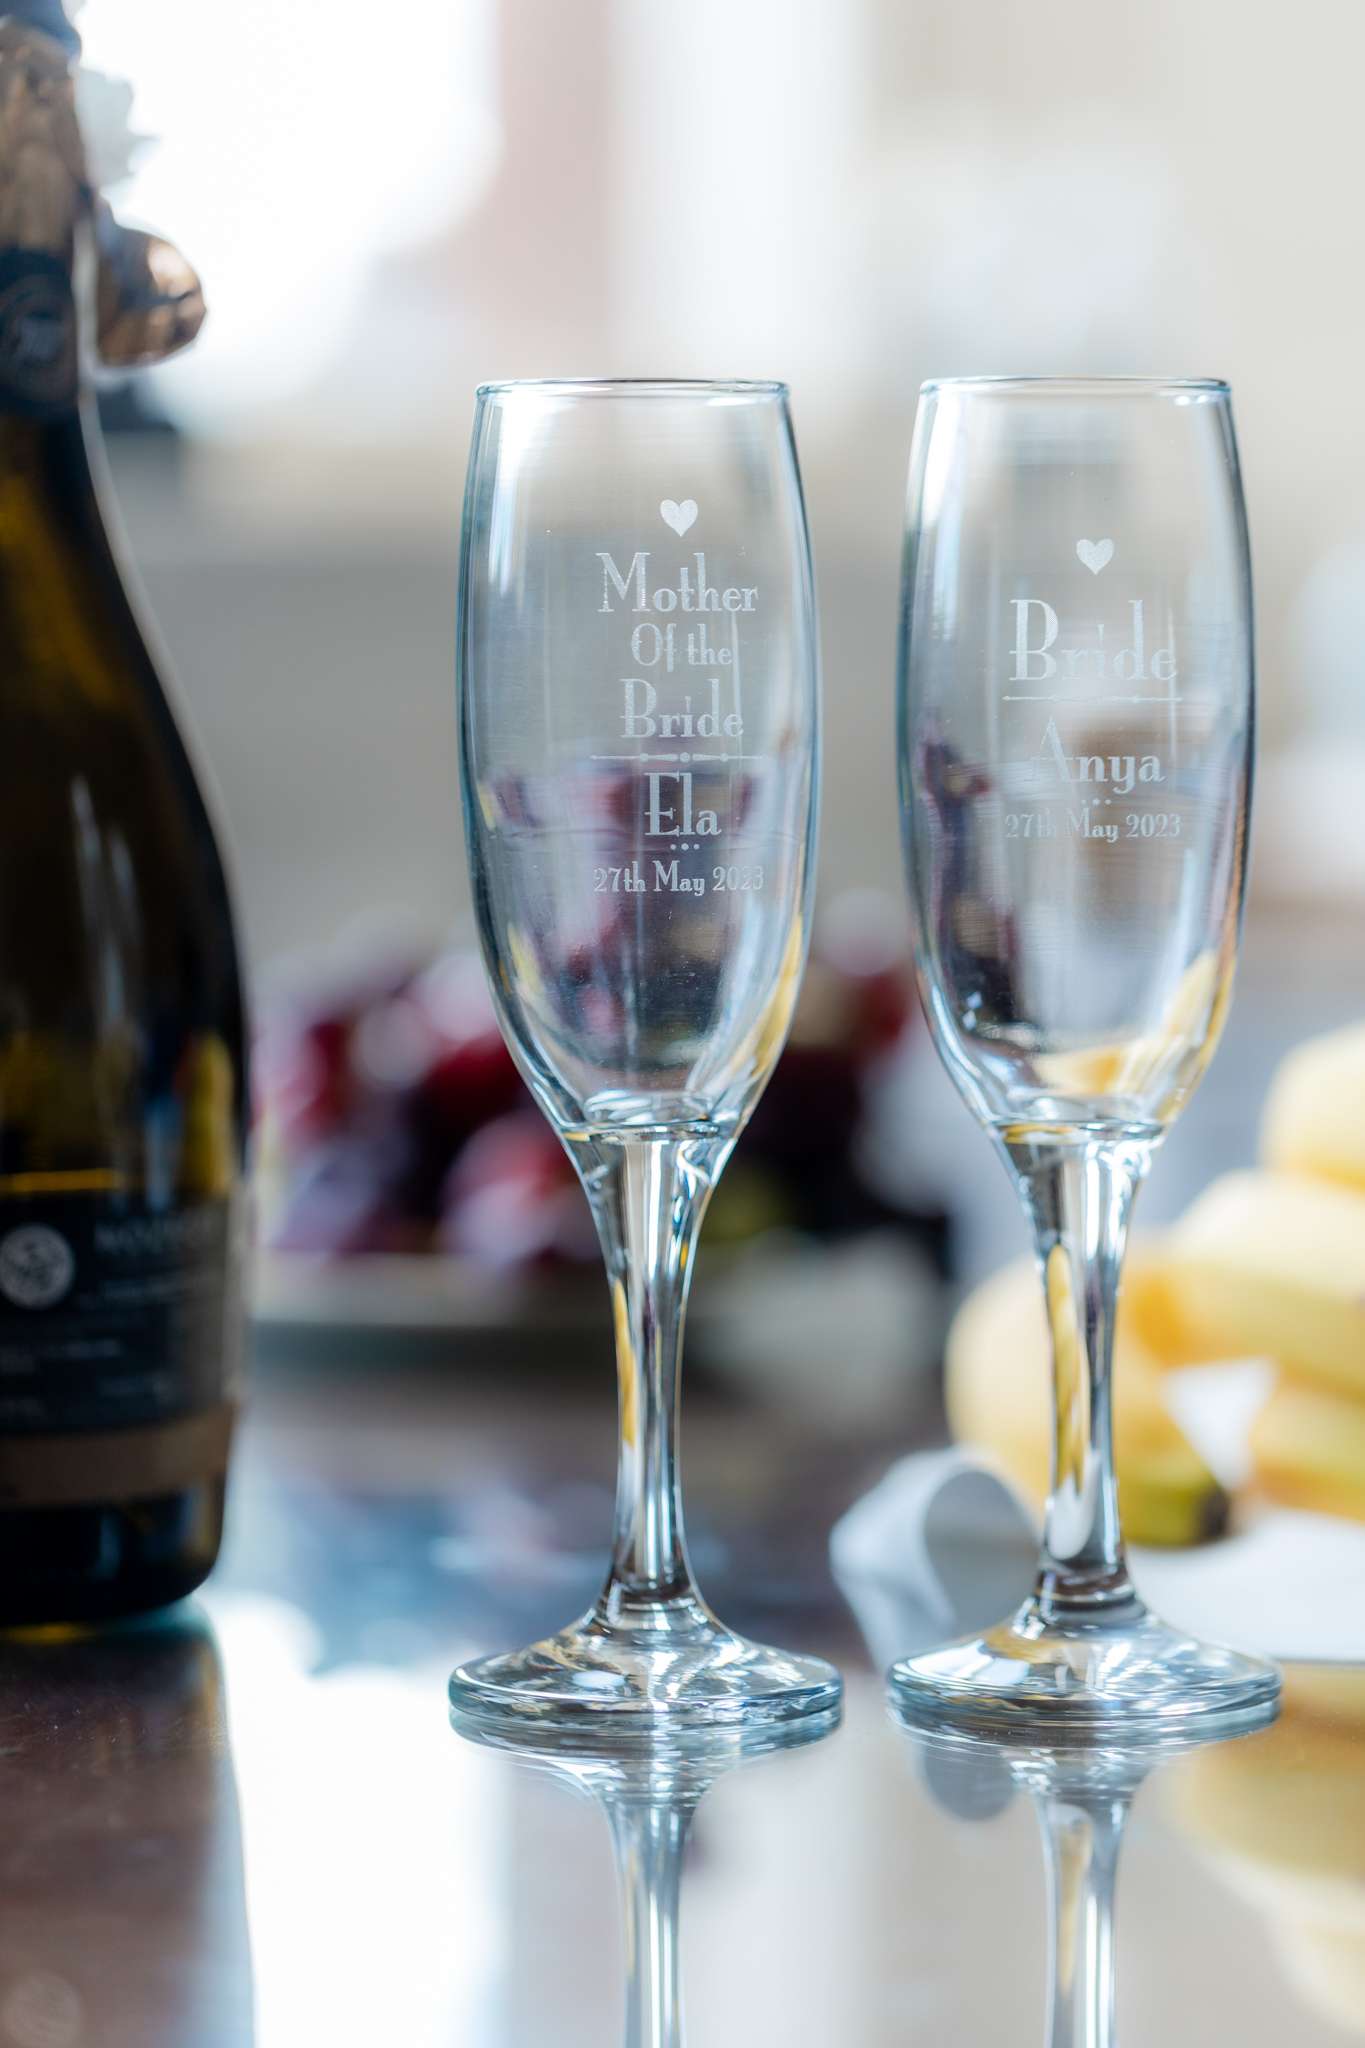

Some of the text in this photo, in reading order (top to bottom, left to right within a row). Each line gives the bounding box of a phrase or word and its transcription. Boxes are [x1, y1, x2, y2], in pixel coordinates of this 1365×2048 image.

[595, 552, 759, 612] Mother
[631, 622, 733, 672] Of the
[1008, 599, 1177, 681] Bride
[619, 678, 744, 738] Bride
[1031, 714, 1166, 794] Anya
[643, 770, 722, 836] Ela
[1004, 806, 1183, 843] 27th May 2023
[593, 859, 765, 896] 27th May 2023
